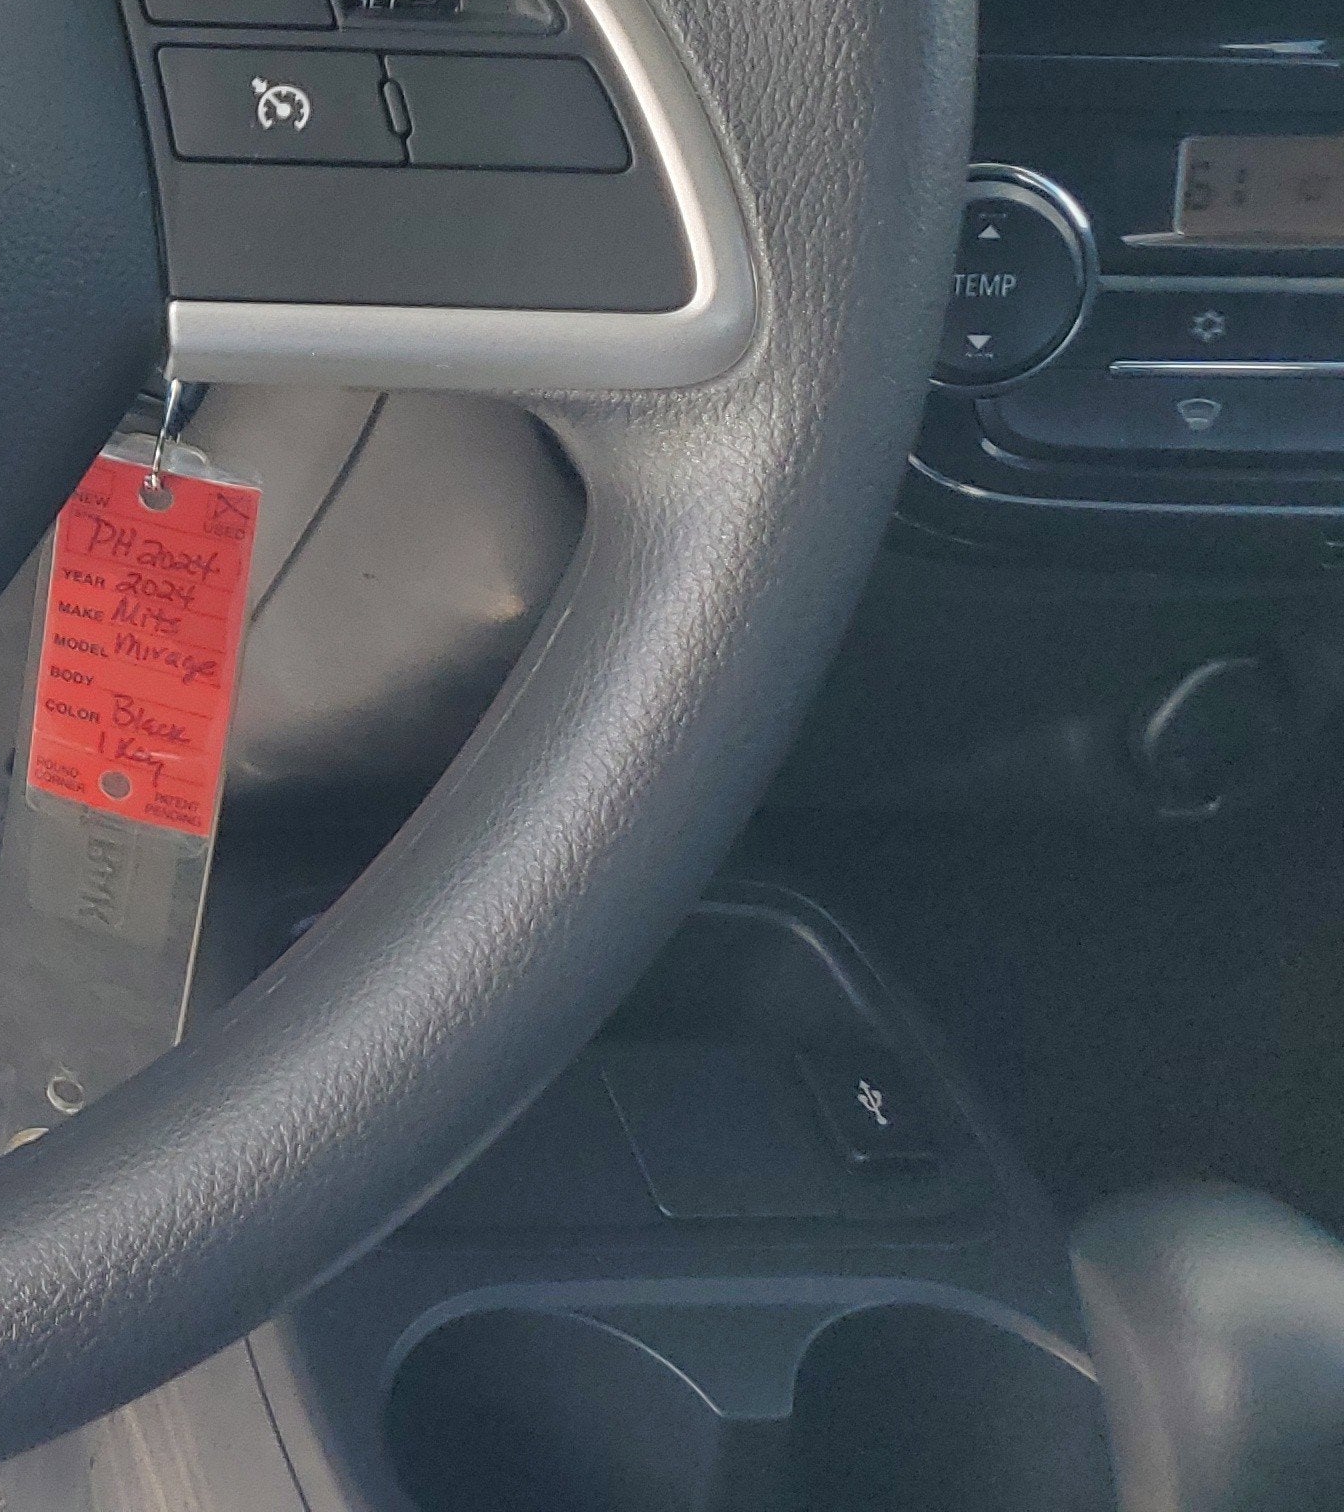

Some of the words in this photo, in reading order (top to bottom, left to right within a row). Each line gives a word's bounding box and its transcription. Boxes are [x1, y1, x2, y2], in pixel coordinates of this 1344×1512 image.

[954, 273, 1017, 298] TEMP
[63, 569, 106, 588] YEAR
[115, 571, 196, 610] 2024
[57, 600, 104, 622] MAKE
[53, 633, 109, 659] MODEL
[49, 666, 95, 687] BODY
[44, 697, 102, 725] COLOR
